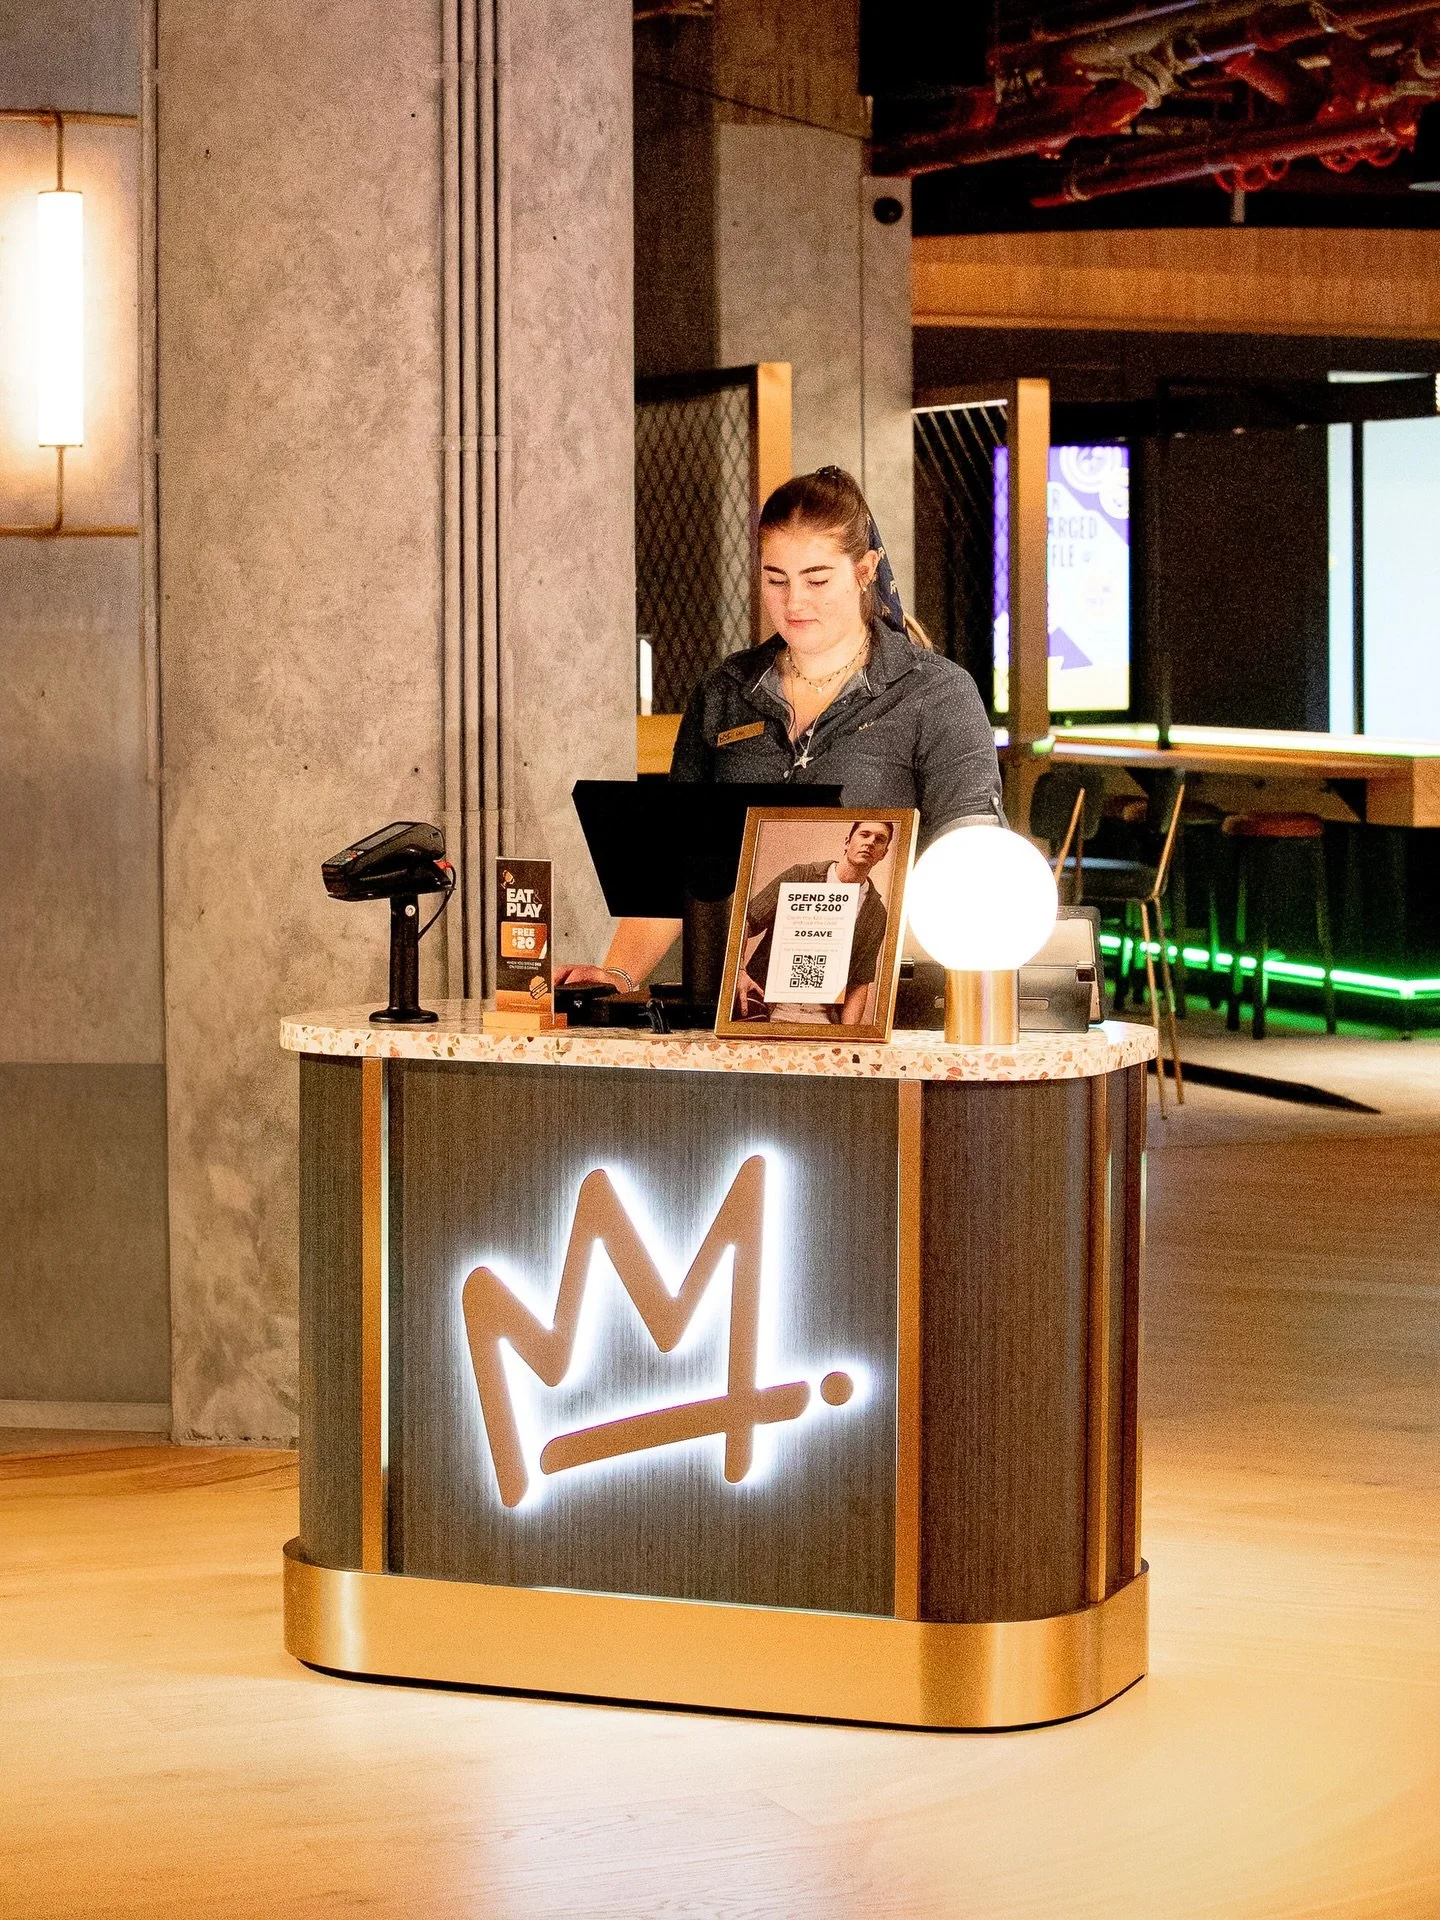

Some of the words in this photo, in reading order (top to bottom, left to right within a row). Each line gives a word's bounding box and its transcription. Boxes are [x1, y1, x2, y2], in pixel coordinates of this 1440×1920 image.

[506, 888, 534, 903] EAT
[787, 893, 826, 902] SPEND
[828, 893, 849, 903] $80
[506, 902, 543, 918] PLAY
[790, 903, 813, 912] GET
[814, 903, 842, 912] $200
[511, 927, 535, 937] FREE
[794, 930, 833, 938] 20SAVE
[511, 936, 536, 950] $20
